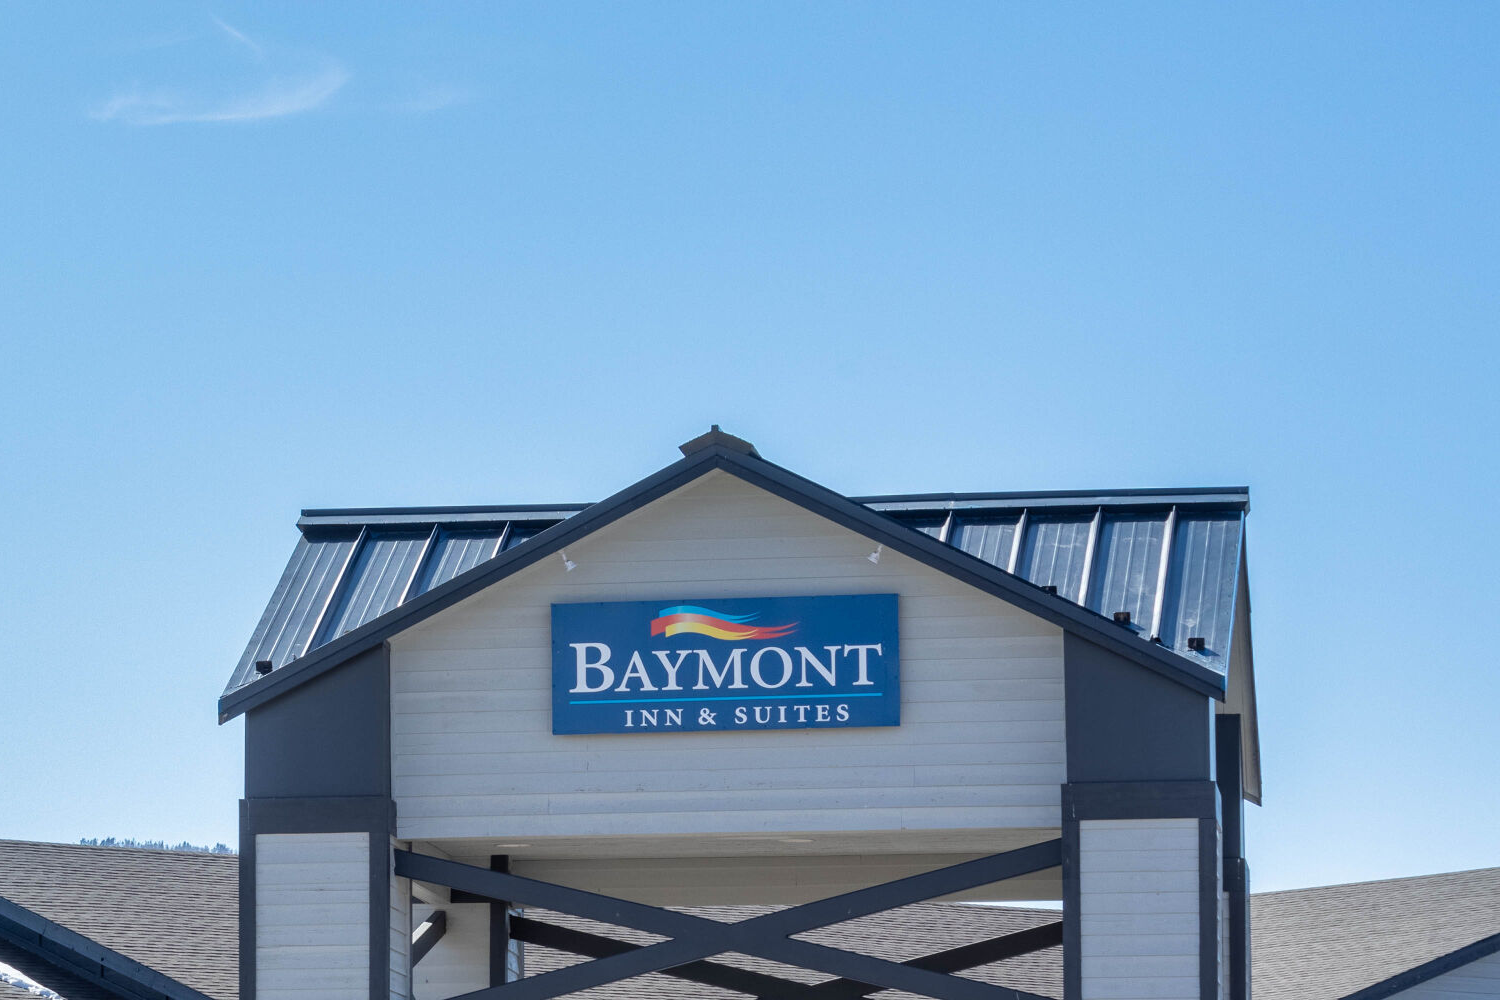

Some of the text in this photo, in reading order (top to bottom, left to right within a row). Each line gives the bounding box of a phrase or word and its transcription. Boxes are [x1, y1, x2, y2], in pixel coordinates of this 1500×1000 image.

[569, 643, 882, 693] BAYMONT
[625, 704, 850, 727] INN & SUITES
